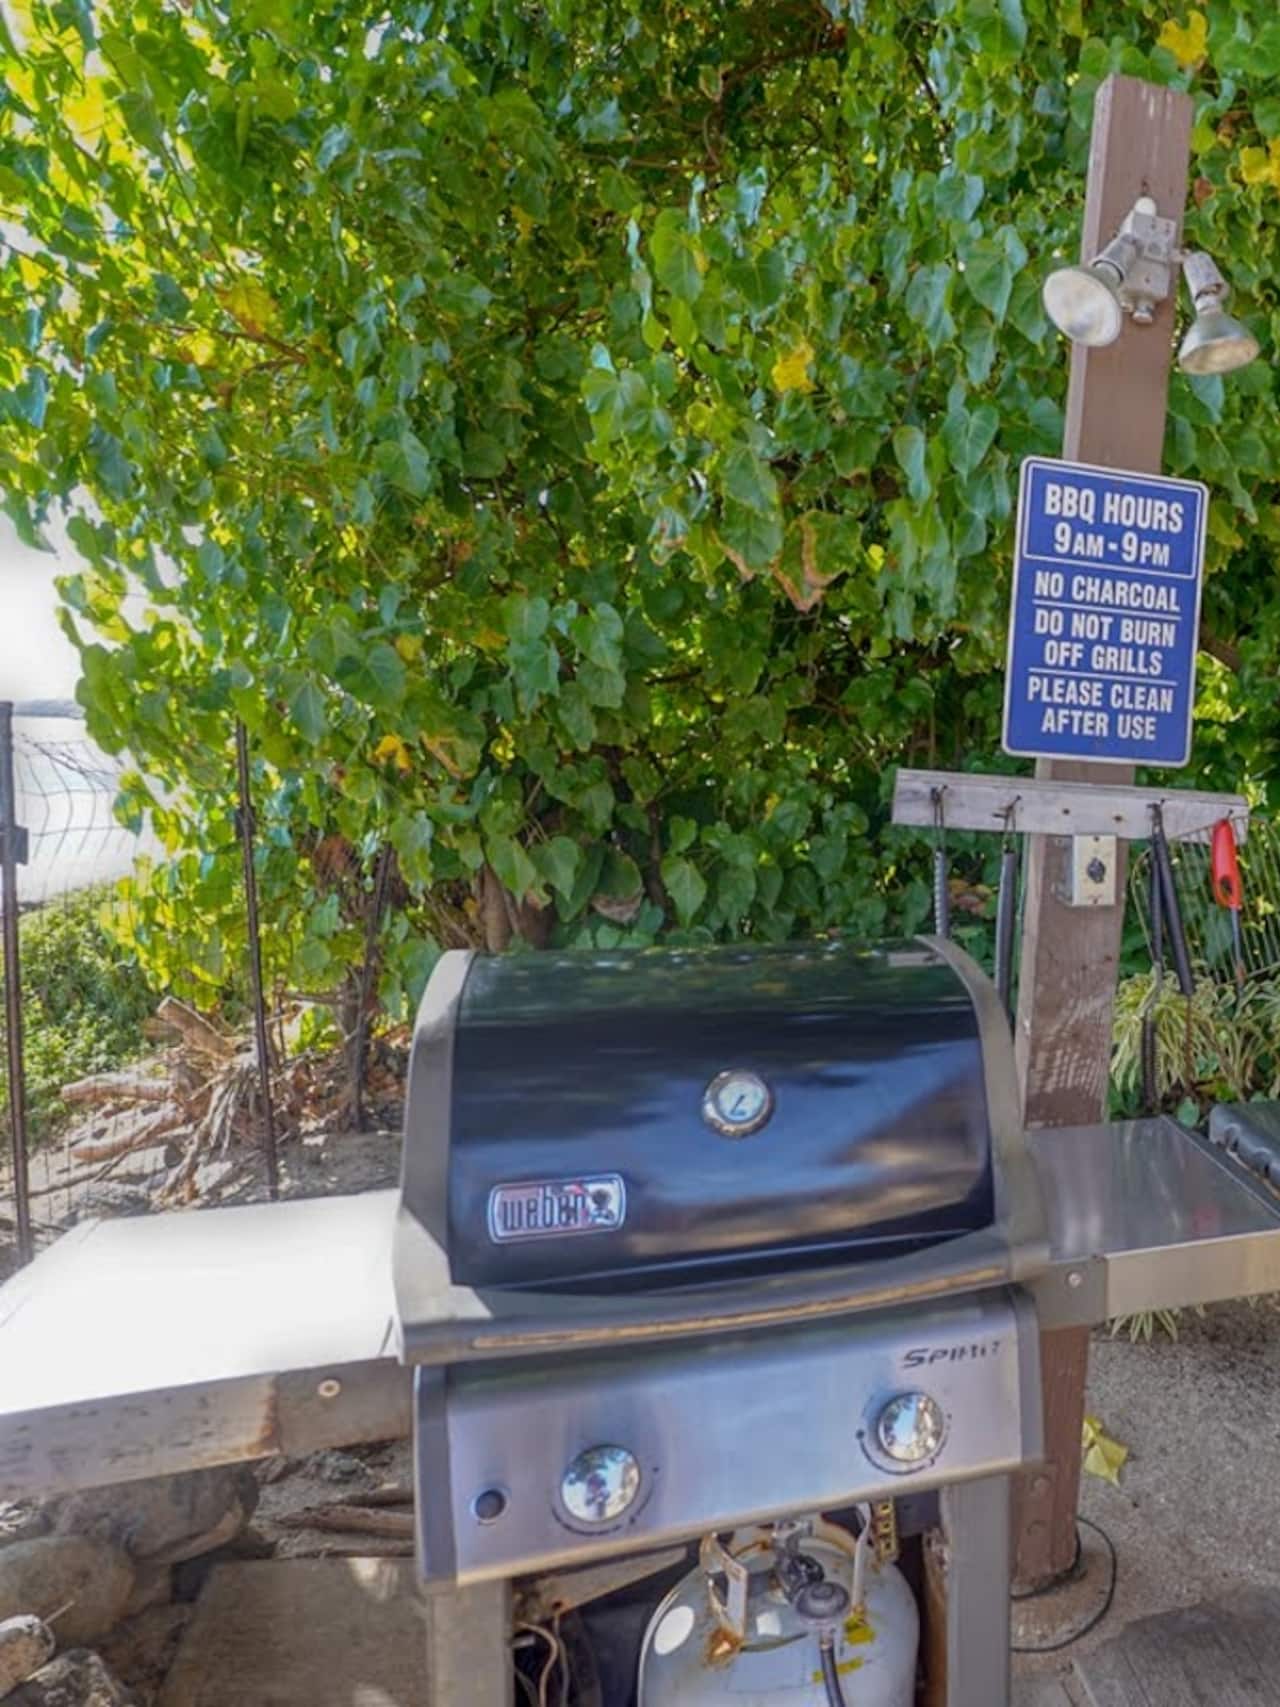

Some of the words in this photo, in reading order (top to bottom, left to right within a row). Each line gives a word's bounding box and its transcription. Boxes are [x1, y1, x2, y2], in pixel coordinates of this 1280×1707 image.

[1044, 482, 1096, 524] BBQ
[1102, 490, 1185, 534] HOURS
[1034, 570, 1064, 598] NO
[1071, 574, 1181, 613] CHARCOAL
[1034, 609, 1064, 636] DO
[1071, 612, 1114, 642] NOT
[1120, 618, 1176, 649] BURN
[1044, 640, 1084, 668] OFF
[1091, 645, 1163, 677] GRILLS
[1028, 675, 1104, 708] PLEASE
[1110, 682, 1174, 714] CLEAN
[1041, 707, 1109, 738] AFTER
[1117, 714, 1157, 742] USE
